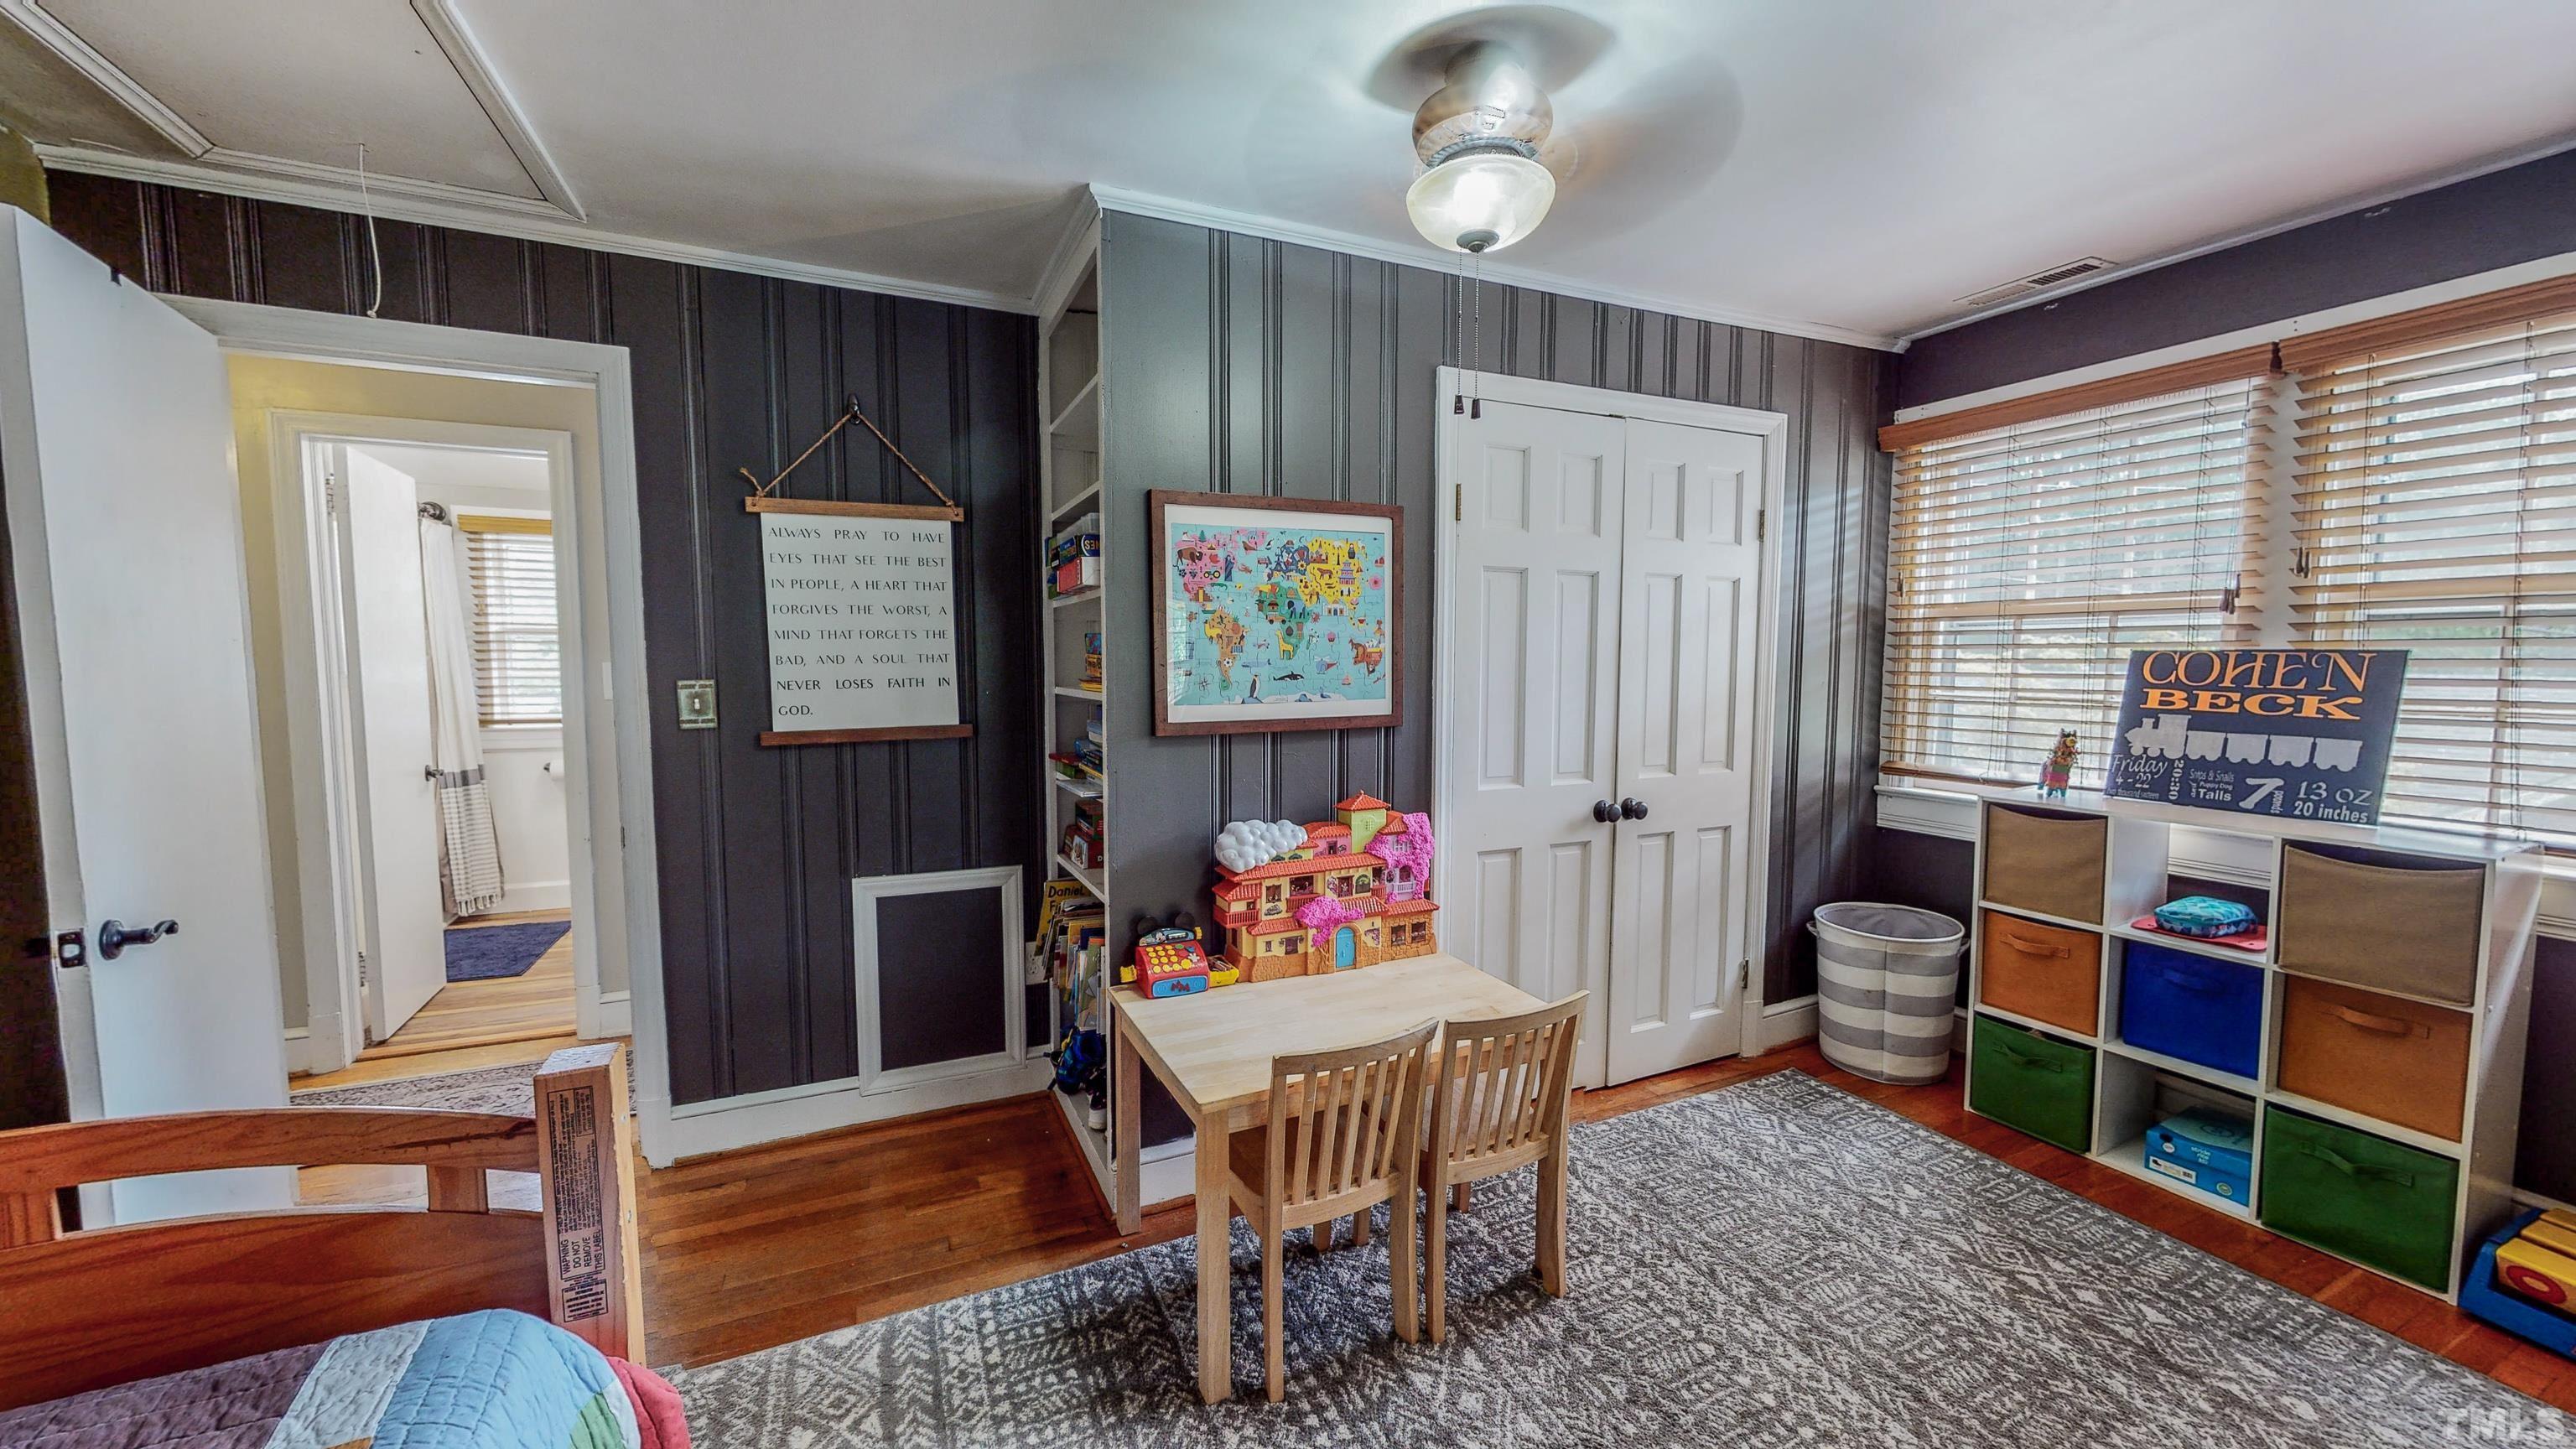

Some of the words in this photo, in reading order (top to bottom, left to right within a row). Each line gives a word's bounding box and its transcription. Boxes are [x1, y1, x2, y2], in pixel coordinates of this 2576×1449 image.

[768, 527, 821, 539] ALWAYS
[834, 529, 868, 541] PRAY
[880, 531, 900, 542] TO
[911, 532, 945, 543] HAVE
[769, 552, 802, 564] EYES
[811, 553, 848, 565] THAT
[854, 554, 876, 566] SEE
[885, 555, 911, 567] THE
[917, 557, 947, 568] BEST
[771, 578, 785, 589] IN
[791, 579, 844, 592] PEOPLE,
[850, 579, 860, 590] A
[865, 579, 908, 591] HEART
[914, 580, 948, 592] THAT
[772, 604, 839, 615] FORGIVES
[847, 604, 874, 615] THE
[882, 605, 931, 618] WORST,
[938, 605, 948, 615] A
[774, 630, 811, 641] MIND
[817, 629, 854, 641] THAT
[859, 629, 917, 640] FORGETS
[922, 629, 948, 640] THE
[775, 654, 807, 667] BAD,
[816, 654, 845, 665] AND
[854, 654, 864, 664] A
[872, 653, 906, 664] SOUL
[917, 652, 951, 664] THAT
[2142, 650, 2378, 693] COHEN
[776, 679, 822, 691] NEVER
[835, 678, 874, 690] LOSES
[887, 677, 925, 688] FAITH
[937, 677, 951, 688] IN
[777, 704, 814, 718] GOD.
[2139, 688, 2363, 721] BECK
[2111, 754, 2168, 779] Friday
[2134, 772, 2152, 788] 22
[2168, 759, 2184, 800] 20:30
[2198, 788, 2232, 802] Tails
[2238, 777, 2285, 810] 7
[2297, 781, 2329, 800] 13
[2293, 801, 2314, 817] 20
[2318, 803, 2369, 823] inches
[571, 1241, 580, 1256] NOT
[592, 1229, 602, 1253] LABEL
[582, 1236, 592, 1268] REMOVE
[573, 1256, 582, 1269] DO
[595, 1253, 603, 1270] THIS
